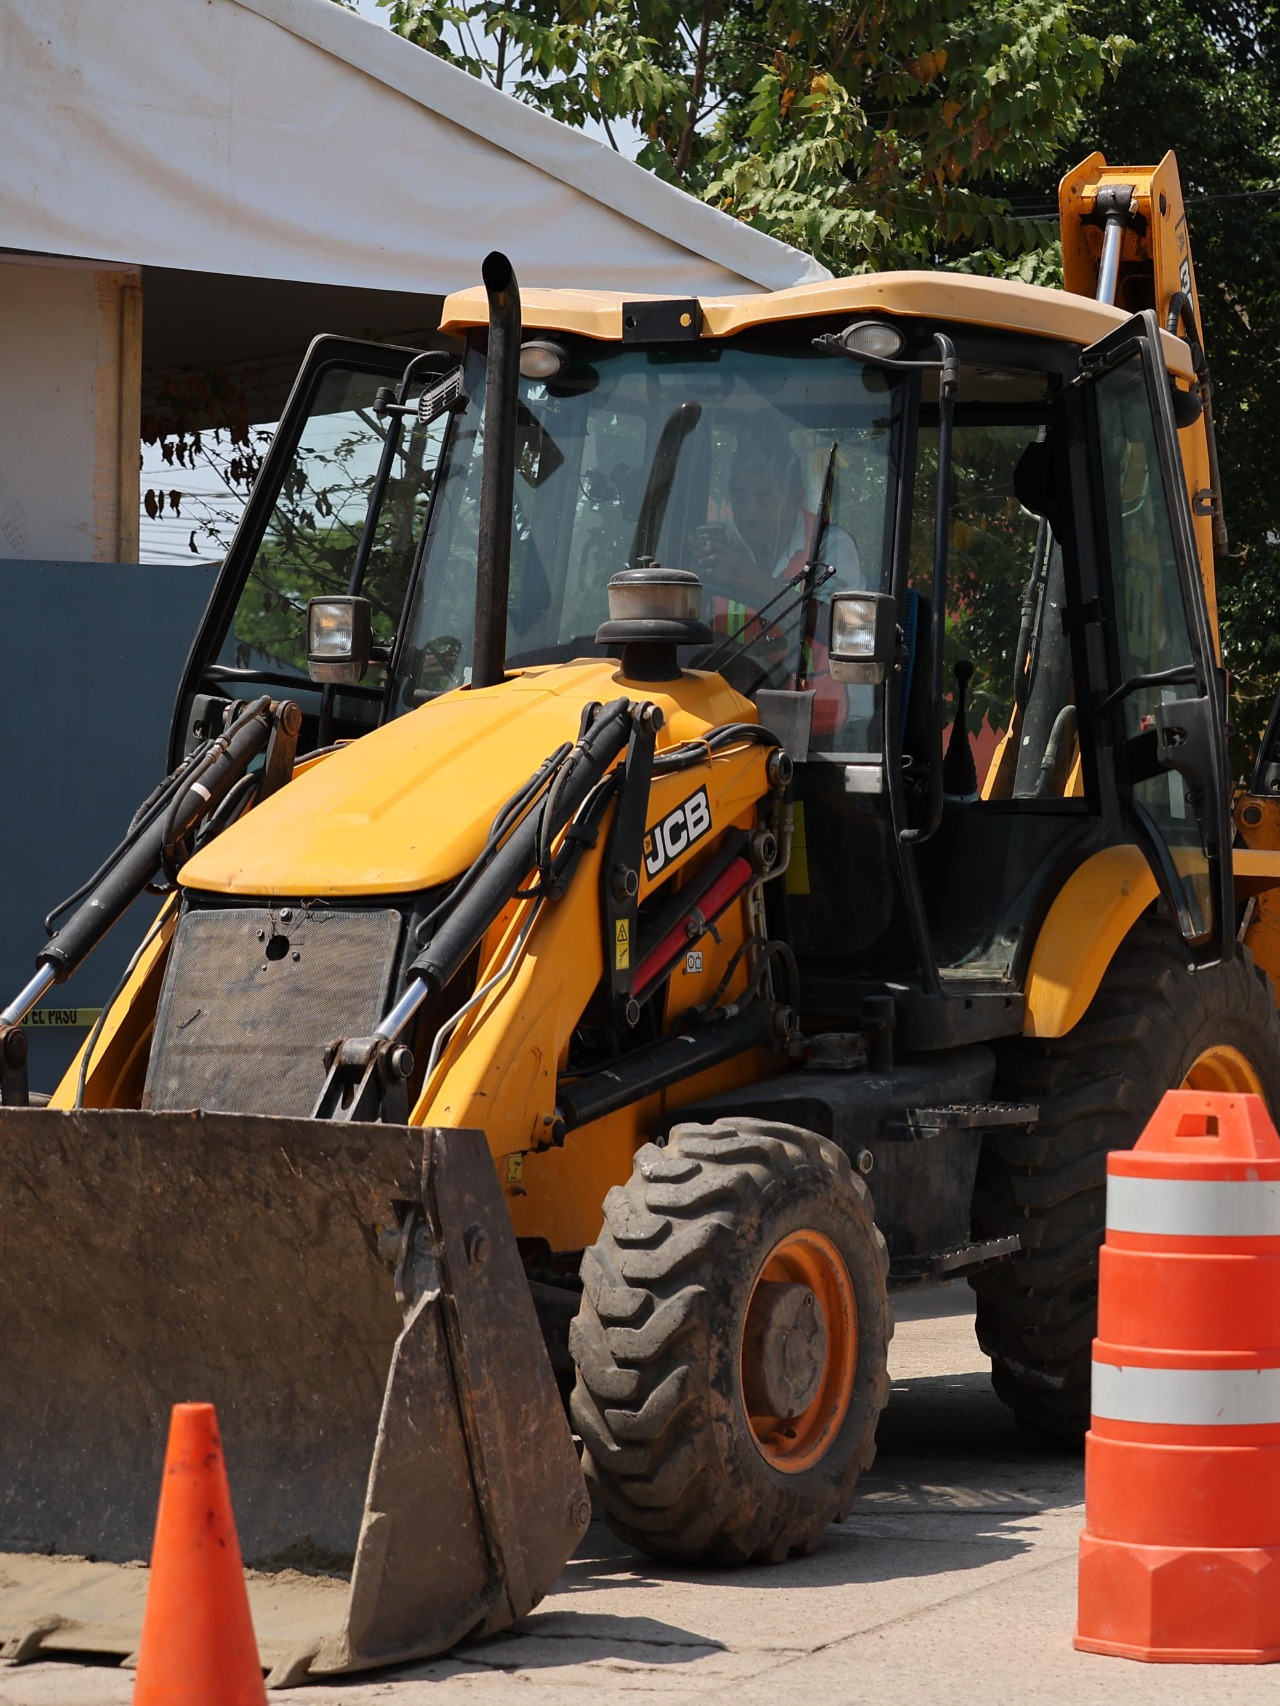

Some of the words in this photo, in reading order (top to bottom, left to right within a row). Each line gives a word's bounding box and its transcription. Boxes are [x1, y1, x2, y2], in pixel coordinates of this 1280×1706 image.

[646, 791, 710, 875] JCB
[32, 1009, 46, 1025] EL
[48, 1009, 78, 1025] PASO
